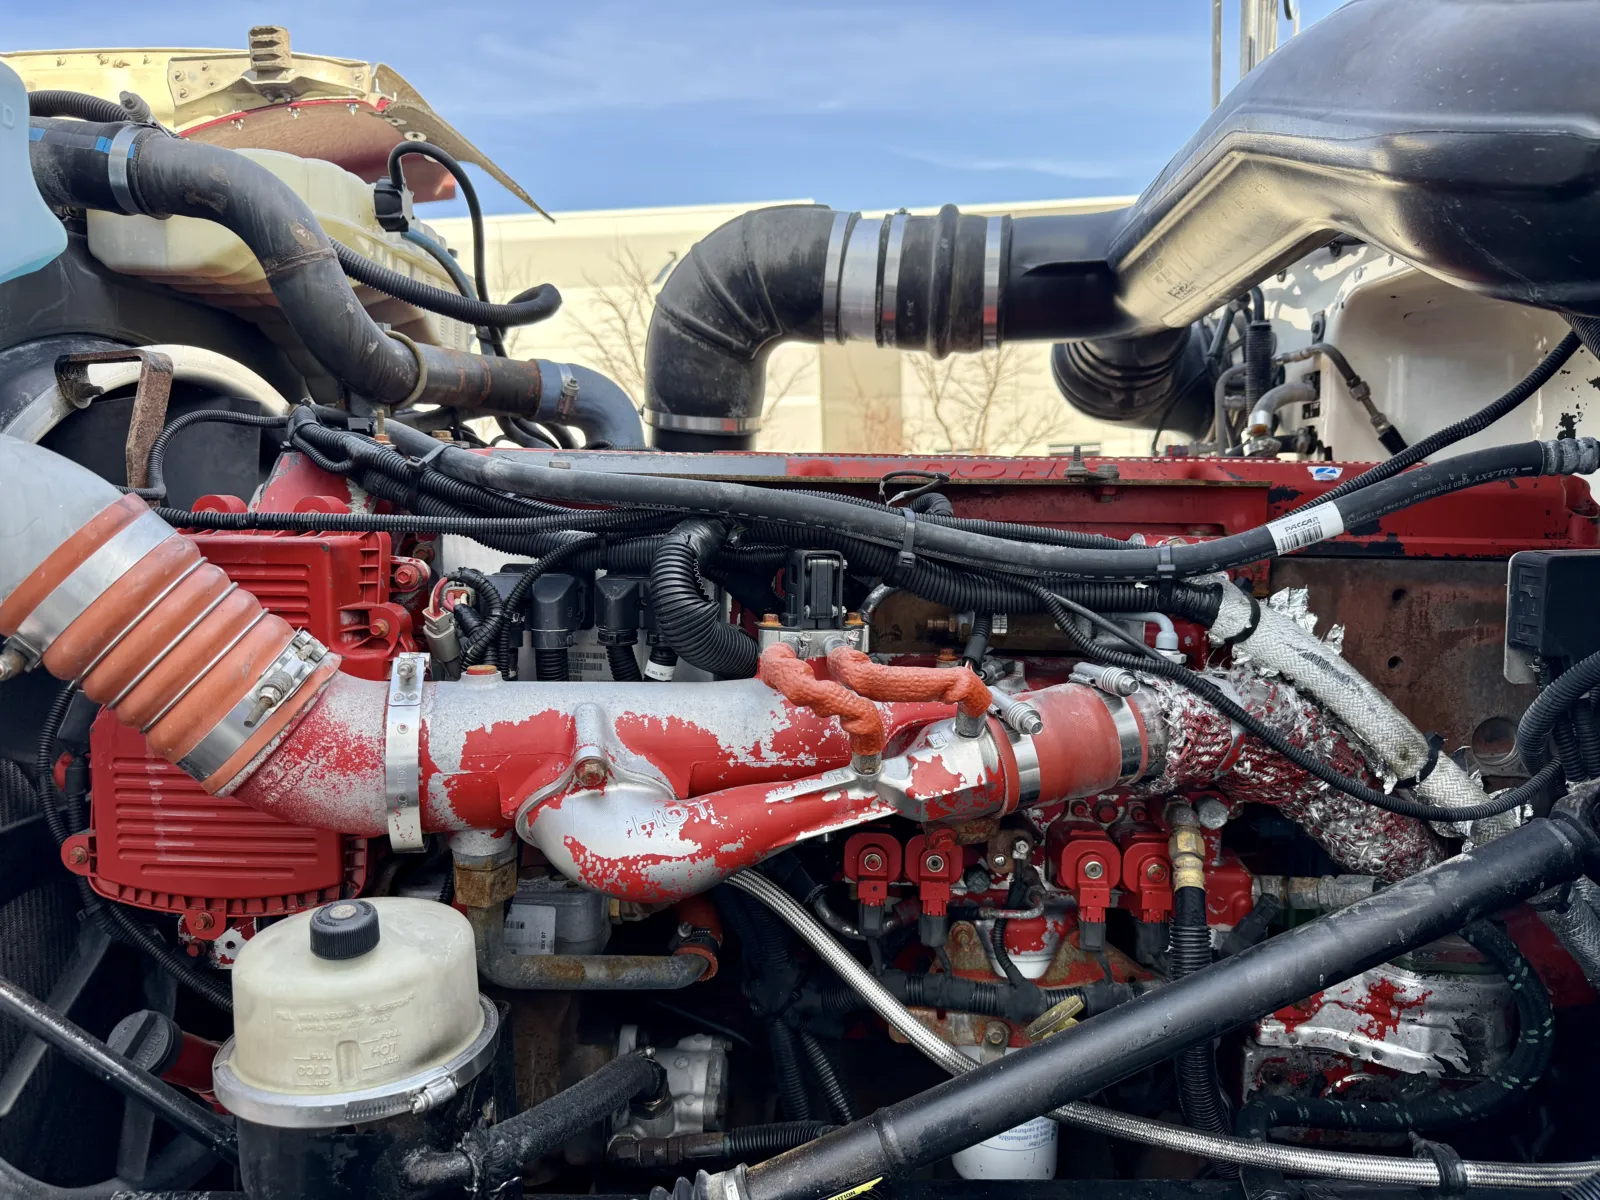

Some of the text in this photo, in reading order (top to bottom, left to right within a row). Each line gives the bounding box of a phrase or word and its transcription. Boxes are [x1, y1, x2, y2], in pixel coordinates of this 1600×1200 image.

[1472, 466, 1518, 484] GALAXY
[1453, 478, 1470, 488] 4880
[1412, 482, 1452, 501] FlexBarrier
[1284, 516, 1319, 532] PACCAR
[1041, 570, 1081, 579] GALAXY
[631, 799, 710, 835] HOT
[275, 1010, 294, 1021] FILL
[297, 1012, 320, 1022] WITH
[295, 1012, 393, 1033] APPROVED ATF ONLY
[380, 1028, 402, 1039] FULL
[370, 1041, 398, 1057] HOT
[310, 1051, 332, 1061] FULL
[382, 1055, 400, 1066] ADD
[296, 1064, 331, 1076] COLD
[313, 1078, 332, 1087] ADD
